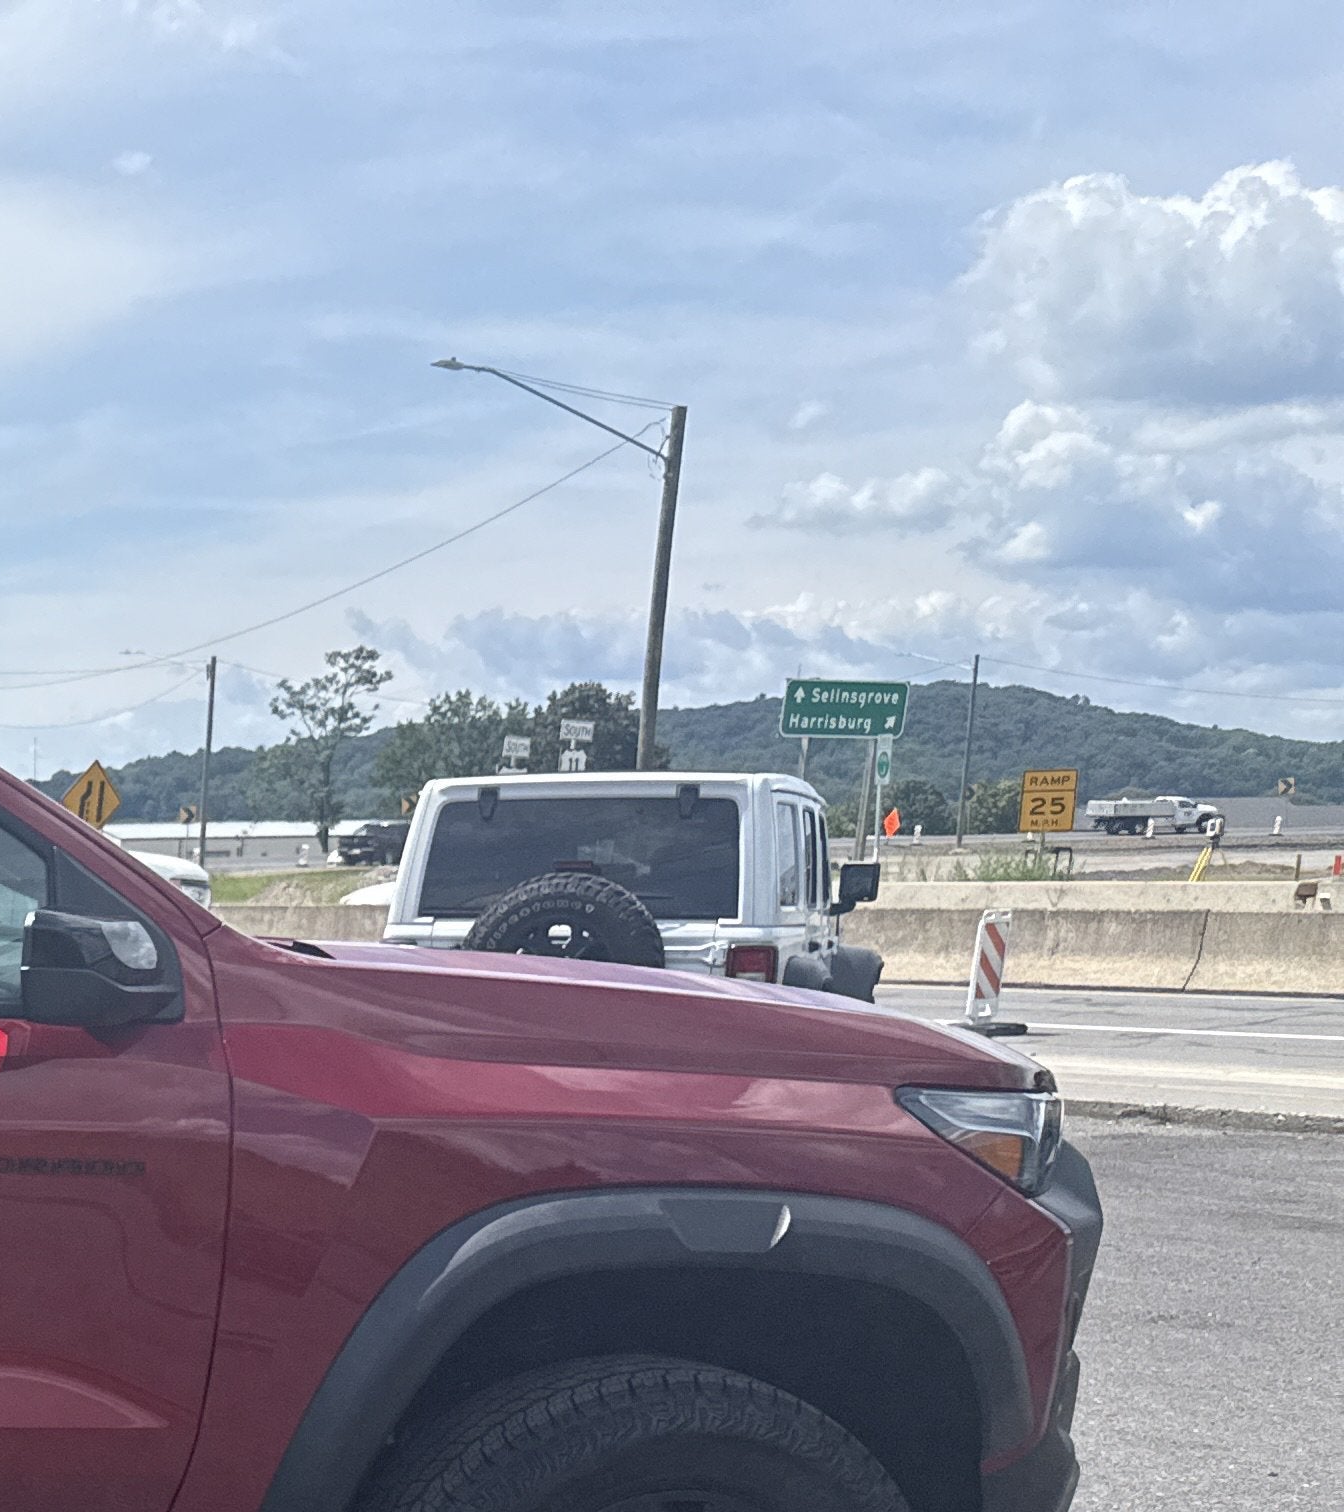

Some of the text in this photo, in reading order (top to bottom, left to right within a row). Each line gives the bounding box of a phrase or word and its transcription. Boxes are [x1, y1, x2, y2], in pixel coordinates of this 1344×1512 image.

[812, 688, 899, 708] Selinsgrove
[564, 724, 591, 737] SOUTH
[789, 713, 872, 734] Harrisburg
[1029, 776, 1071, 786] RAMP
[1029, 797, 1066, 815] 25
